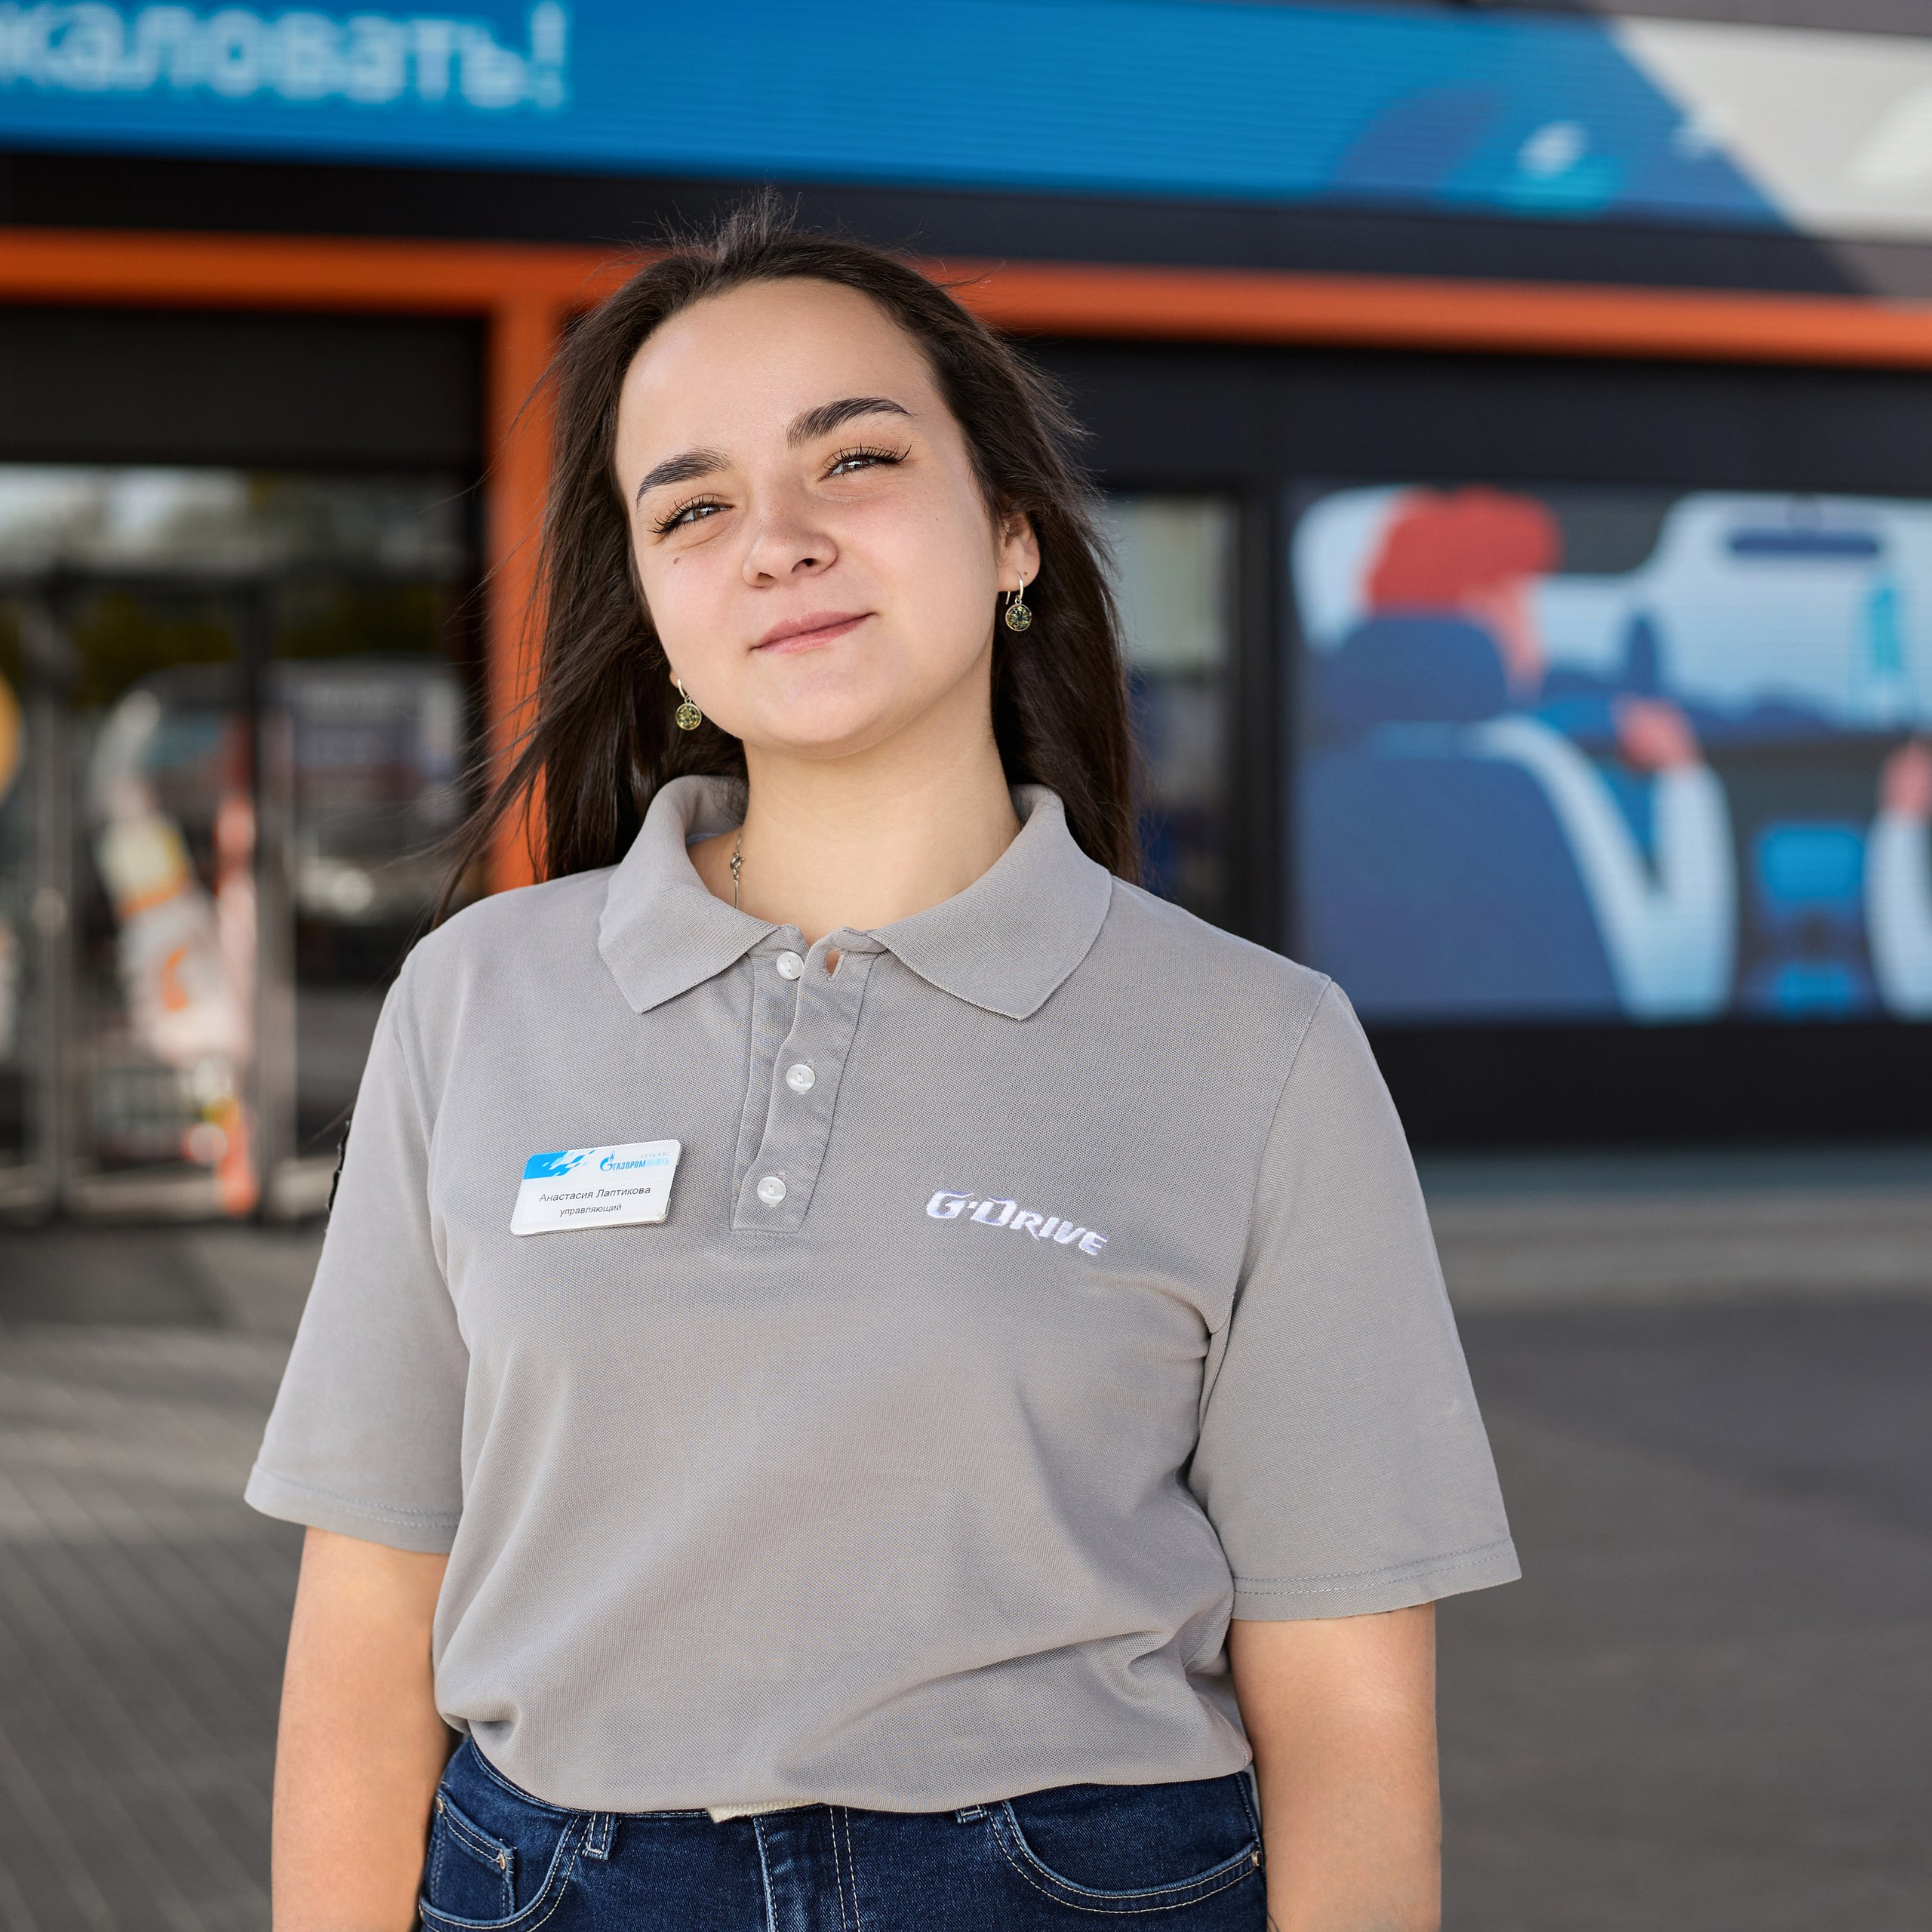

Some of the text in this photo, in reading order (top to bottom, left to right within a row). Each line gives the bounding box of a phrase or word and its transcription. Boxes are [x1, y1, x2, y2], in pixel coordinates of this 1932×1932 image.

[539, 1186, 651, 1202] Анастасия Лаптикова
[559, 1203, 622, 1217] управляющий
